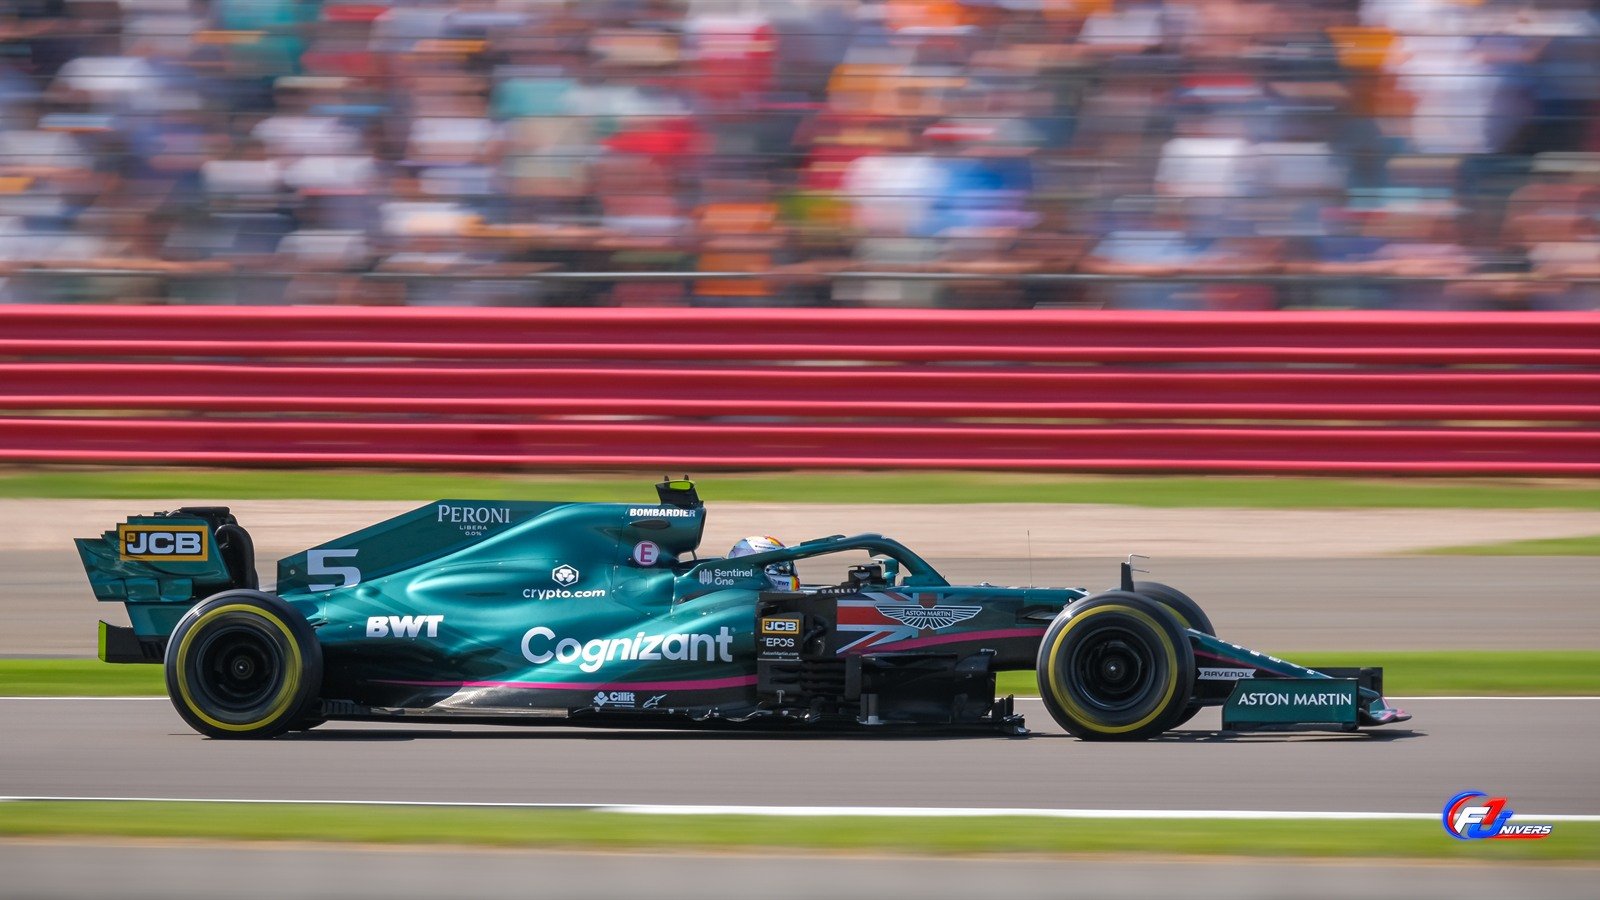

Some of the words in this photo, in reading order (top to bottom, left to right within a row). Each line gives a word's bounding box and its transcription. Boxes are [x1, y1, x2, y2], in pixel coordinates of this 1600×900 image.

[437, 504, 511, 524] PERONI
[629, 508, 696, 517] BOMBARDIER
[126, 532, 201, 554] JCB
[640, 543, 653, 563] E
[306, 548, 362, 592] 5
[714, 568, 753, 577] Sentinel
[714, 578, 735, 586] One
[522, 588, 606, 600] crypto.com
[927, 609, 951, 617] MARTIN
[366, 614, 444, 638] BWT
[765, 621, 797, 631] JCB
[766, 637, 795, 648] EPOS
[521, 626, 734, 673] Cognizant
[1203, 670, 1250, 678] RAVENOL
[609, 691, 635, 702] Cillit
[1238, 692, 1289, 706] ASTON
[1293, 693, 1353, 706] MARTIN
